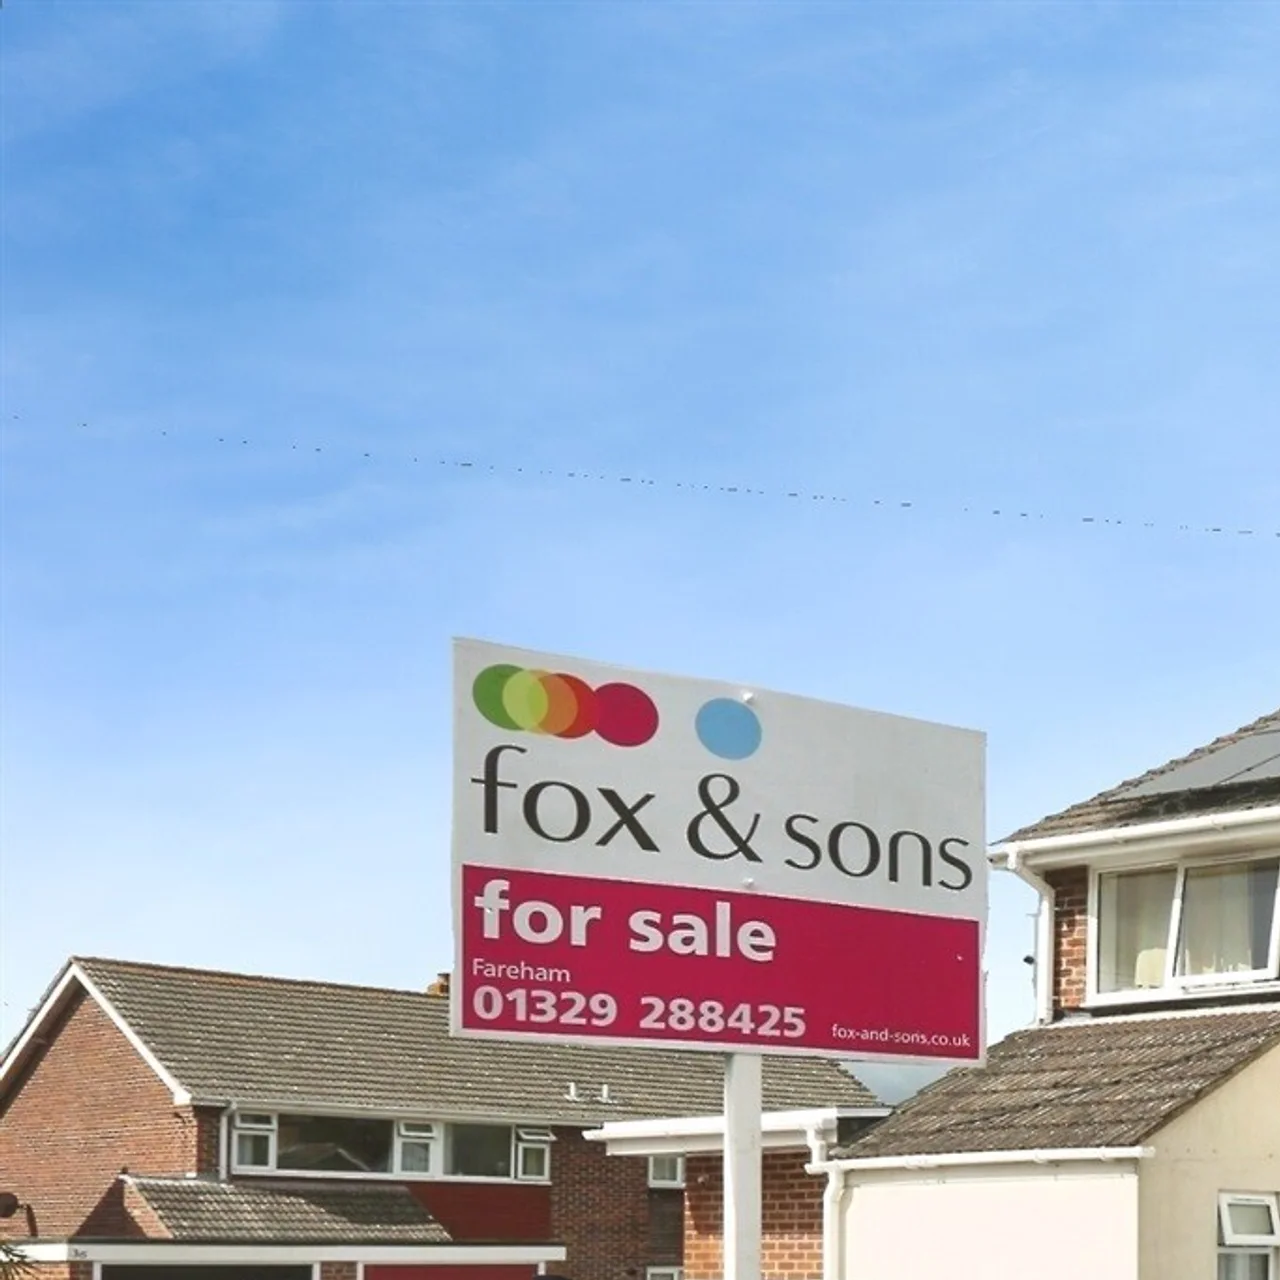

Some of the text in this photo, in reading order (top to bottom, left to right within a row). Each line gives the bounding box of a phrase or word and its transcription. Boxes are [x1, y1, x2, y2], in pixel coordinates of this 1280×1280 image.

[471, 744, 973, 891] fox & sons
[474, 879, 777, 962] for sale
[472, 957, 571, 983] Fareham
[472, 985, 807, 1039] 01329 288425
[831, 1023, 971, 1047] fox-and-sons.co.uk
